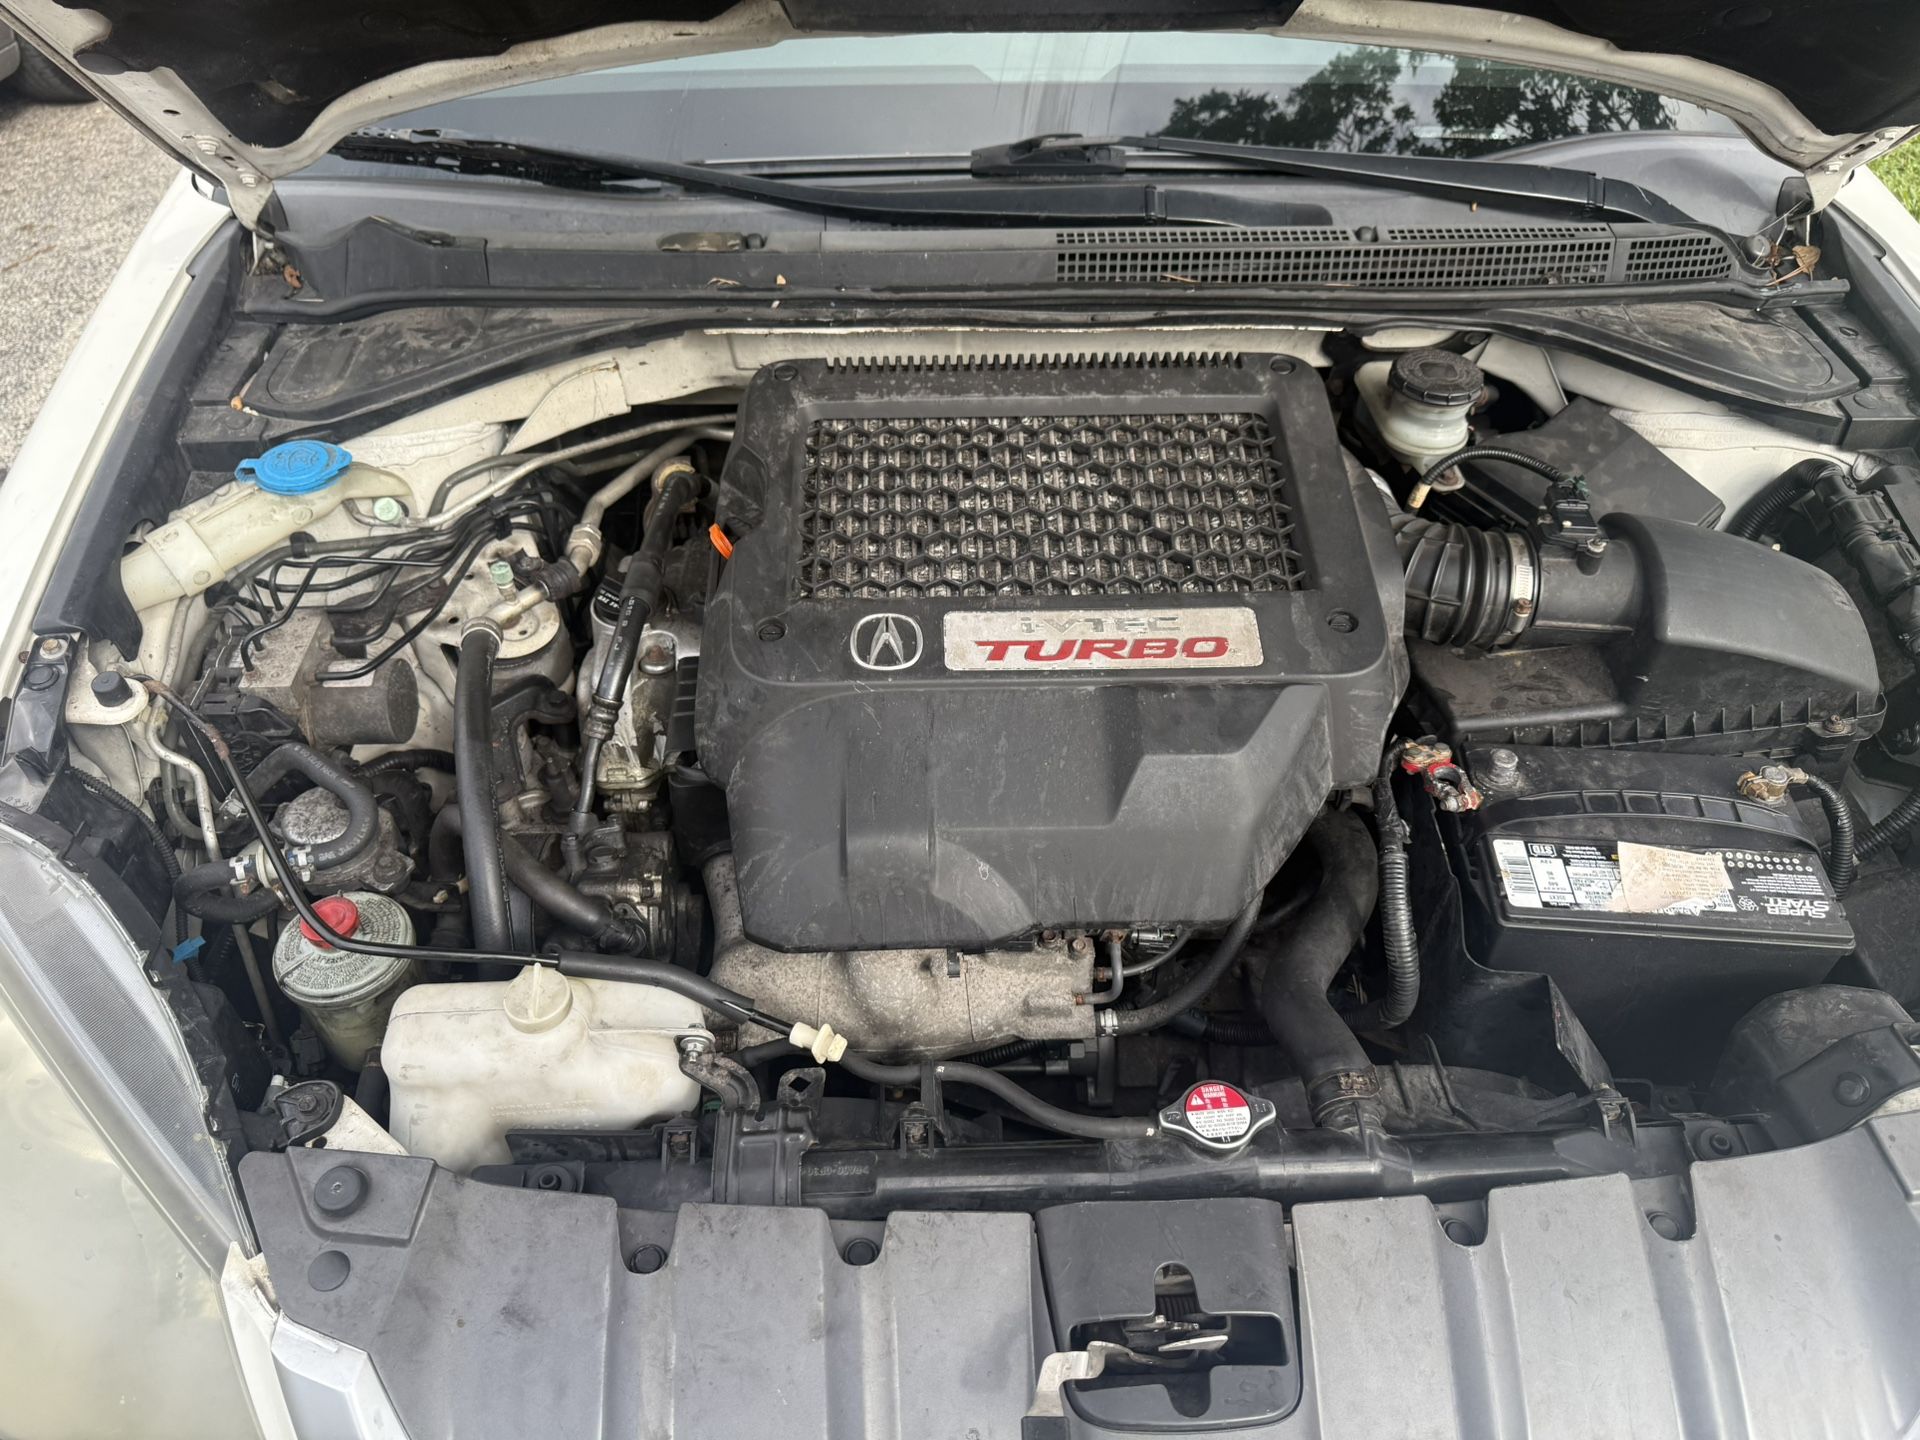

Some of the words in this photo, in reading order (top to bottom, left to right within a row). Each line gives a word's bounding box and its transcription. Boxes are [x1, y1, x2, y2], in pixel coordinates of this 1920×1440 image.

[975, 637, 1229, 663] TURBO
[1532, 845, 1553, 854] STD
[1764, 898, 1829, 912] START
[1767, 906, 1826, 919] SUPER
